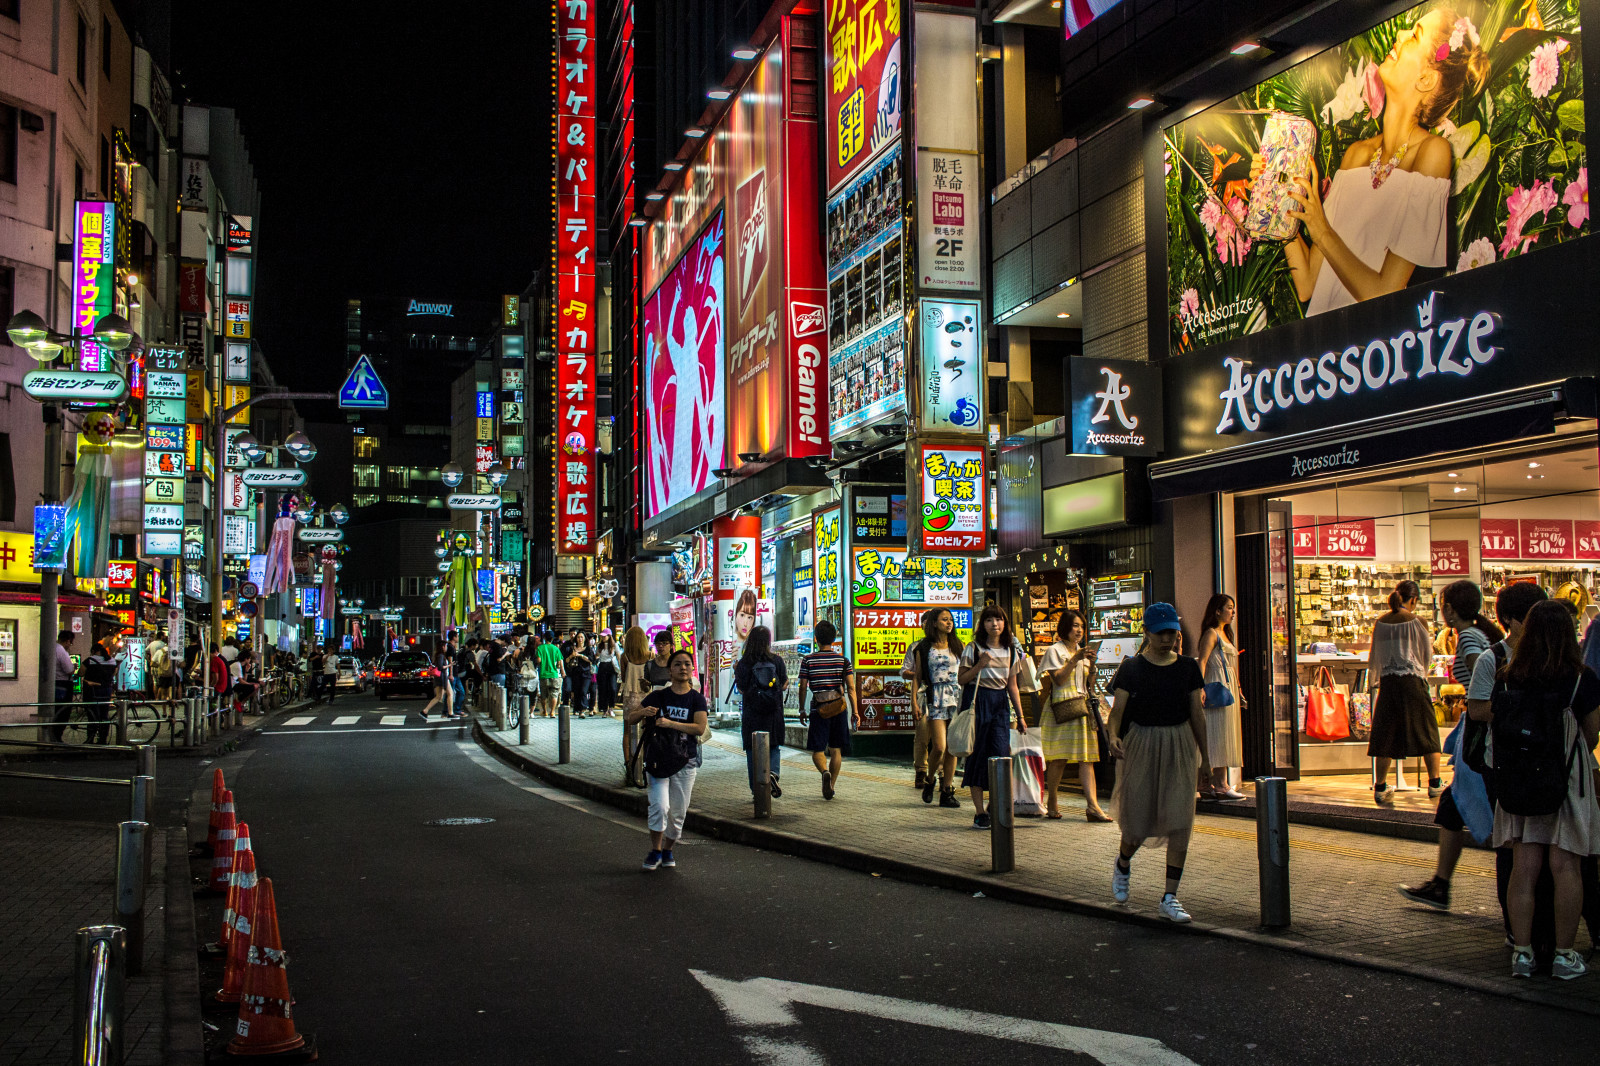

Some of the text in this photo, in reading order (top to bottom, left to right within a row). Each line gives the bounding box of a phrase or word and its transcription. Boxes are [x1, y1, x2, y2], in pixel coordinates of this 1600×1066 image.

[839, 91, 862, 135] 受付
[933, 158, 963, 175] 脱毛
[933, 175, 963, 192] 革命
[934, 193, 962, 204] Datsumo
[935, 202, 963, 218] Labo
[229, 230, 251, 238] CAFE
[934, 227, 964, 237] 脱毛ラボ
[936, 238, 963, 258] 2F
[80, 211, 103, 328] 個室サウナ
[407, 299, 453, 316] Amway
[1182, 292, 1254, 335] Accessorize
[1207, 325, 1228, 337] LONDON
[157, 358, 178, 369] ビル
[1215, 290, 1497, 436] Accessorize
[28, 377, 121, 391] 渋谷センター街
[565, 326, 588, 428] カラオケ
[797, 343, 823, 446] Game!
[1091, 366, 1139, 431] A
[1086, 429, 1145, 447] Accessorize
[924, 451, 983, 479] まんが
[1290, 443, 1361, 478] Accessorize
[934, 477, 976, 501] 喫茶
[566, 461, 588, 546] 歌広場
[925, 535, 982, 549] このビル7F
[1129, 546, 1136, 560] 2
[244, 586, 255, 595] 30
[798, 596, 808, 626] UP
